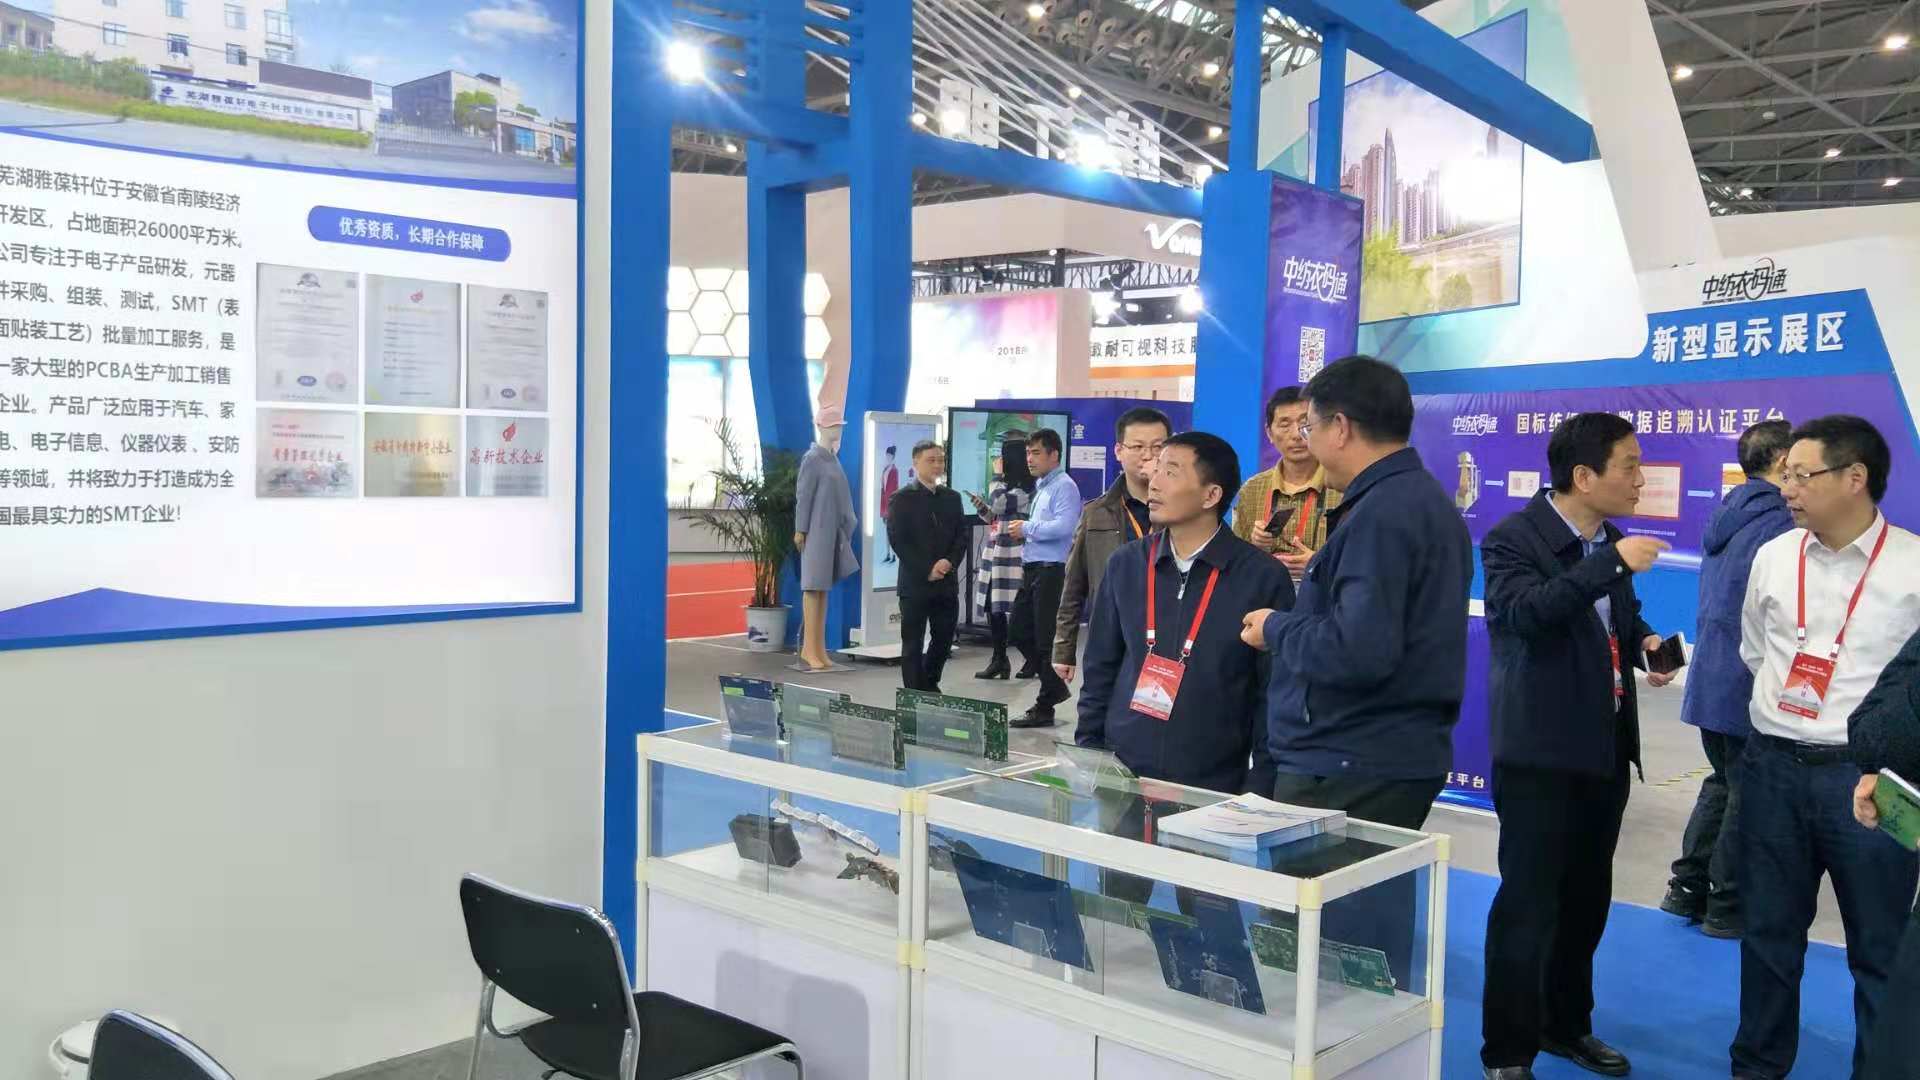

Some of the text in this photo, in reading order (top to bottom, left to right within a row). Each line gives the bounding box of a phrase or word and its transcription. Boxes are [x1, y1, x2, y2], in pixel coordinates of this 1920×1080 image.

[339, 216, 485, 252] 优秀资质，长期合作保障
[1702, 260, 1787, 301] 中纺衣码通
[1652, 311, 1847, 363] 新型显示展区
